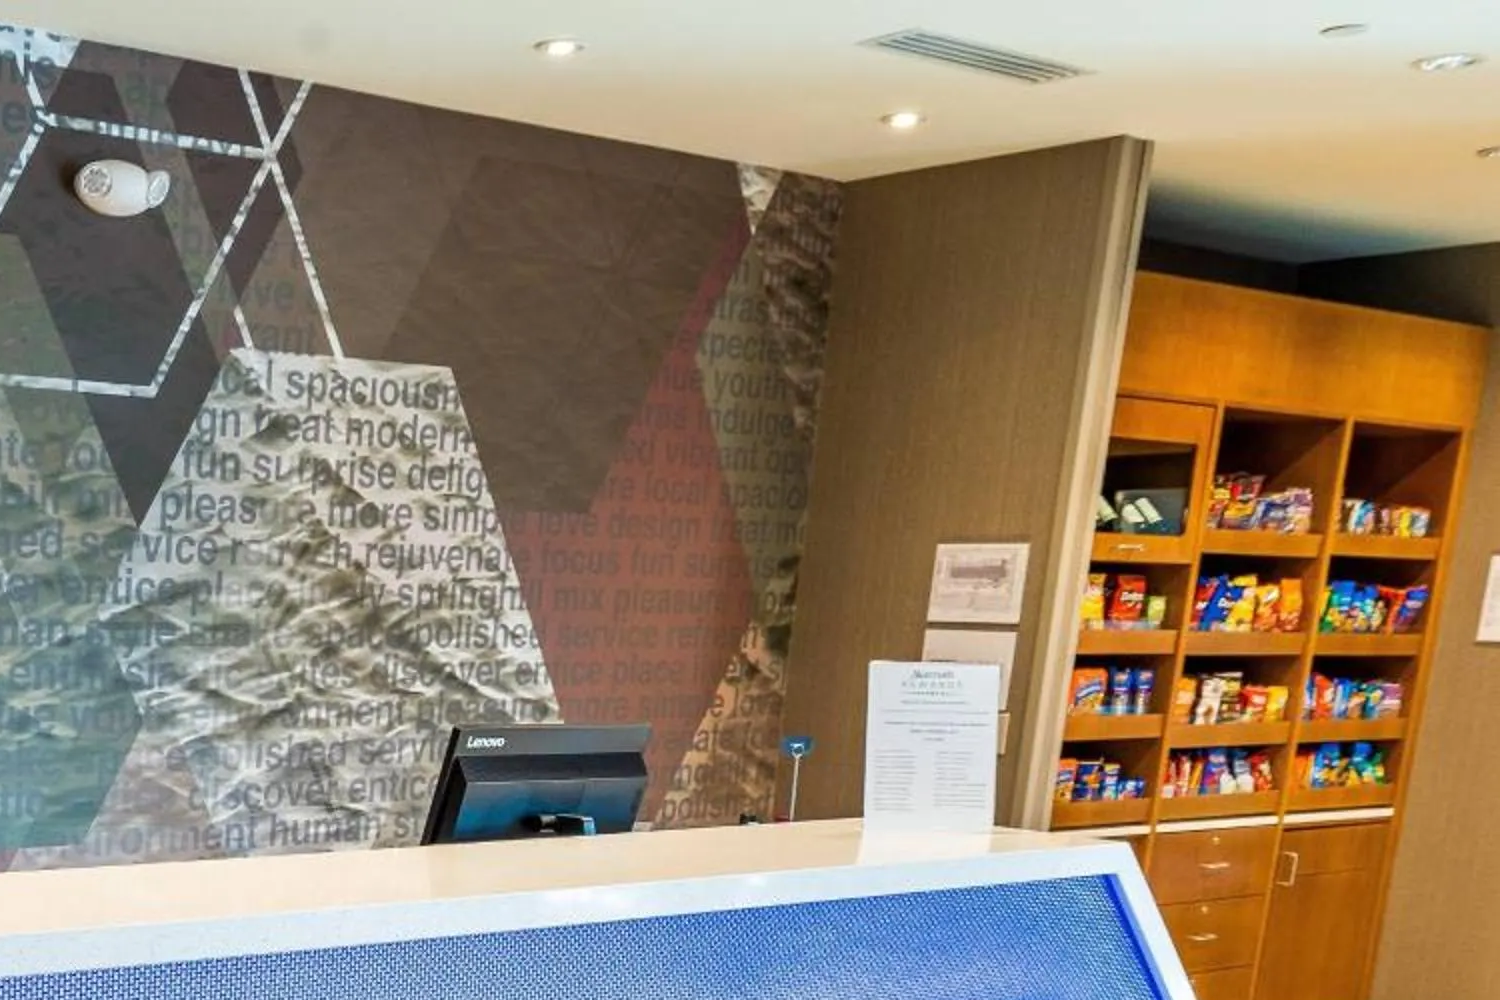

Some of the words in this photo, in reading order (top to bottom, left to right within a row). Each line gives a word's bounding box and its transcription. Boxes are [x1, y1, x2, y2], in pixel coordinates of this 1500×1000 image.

[181, 438, 241, 482] fun
[328, 506, 412, 532] more
[466, 735, 506, 749] Lenovo
